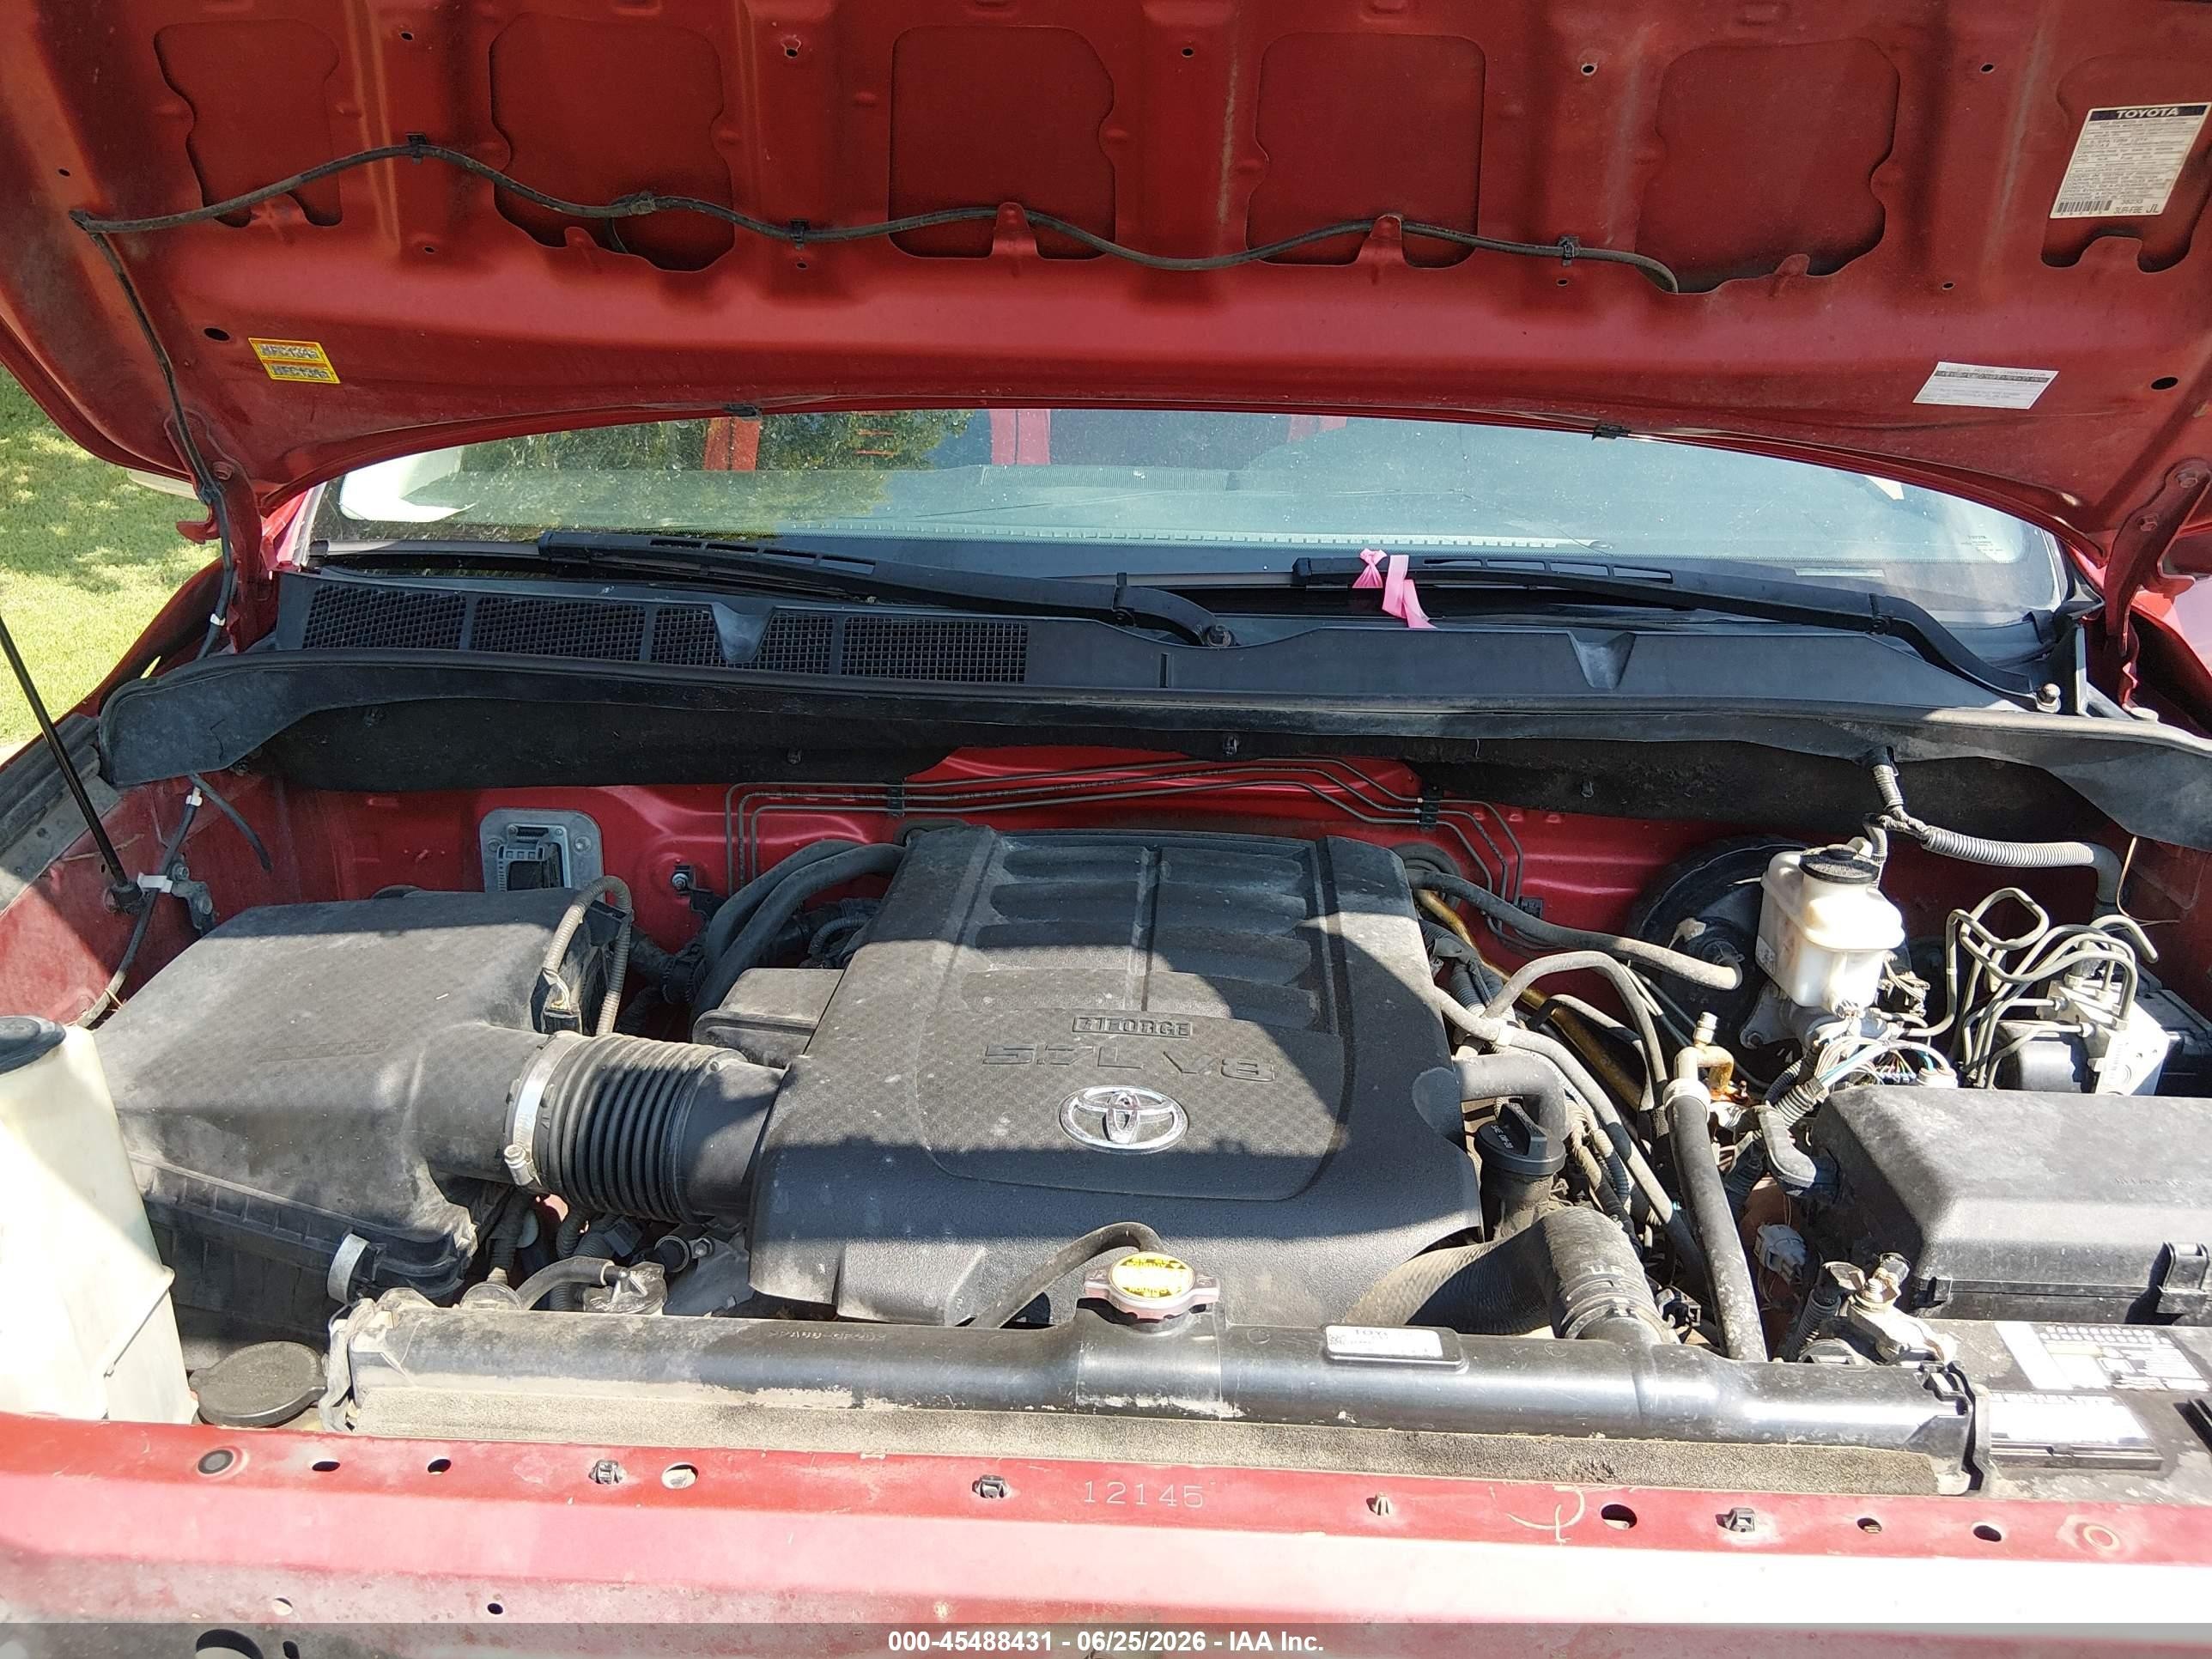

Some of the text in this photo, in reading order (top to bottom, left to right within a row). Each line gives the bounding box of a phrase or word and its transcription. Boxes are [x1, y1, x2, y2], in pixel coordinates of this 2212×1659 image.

[2116, 107, 2179, 119] TOYOTA
[982, 1044, 1274, 1082] 5.7L V8
[1084, 1480, 1204, 1509] 12145
